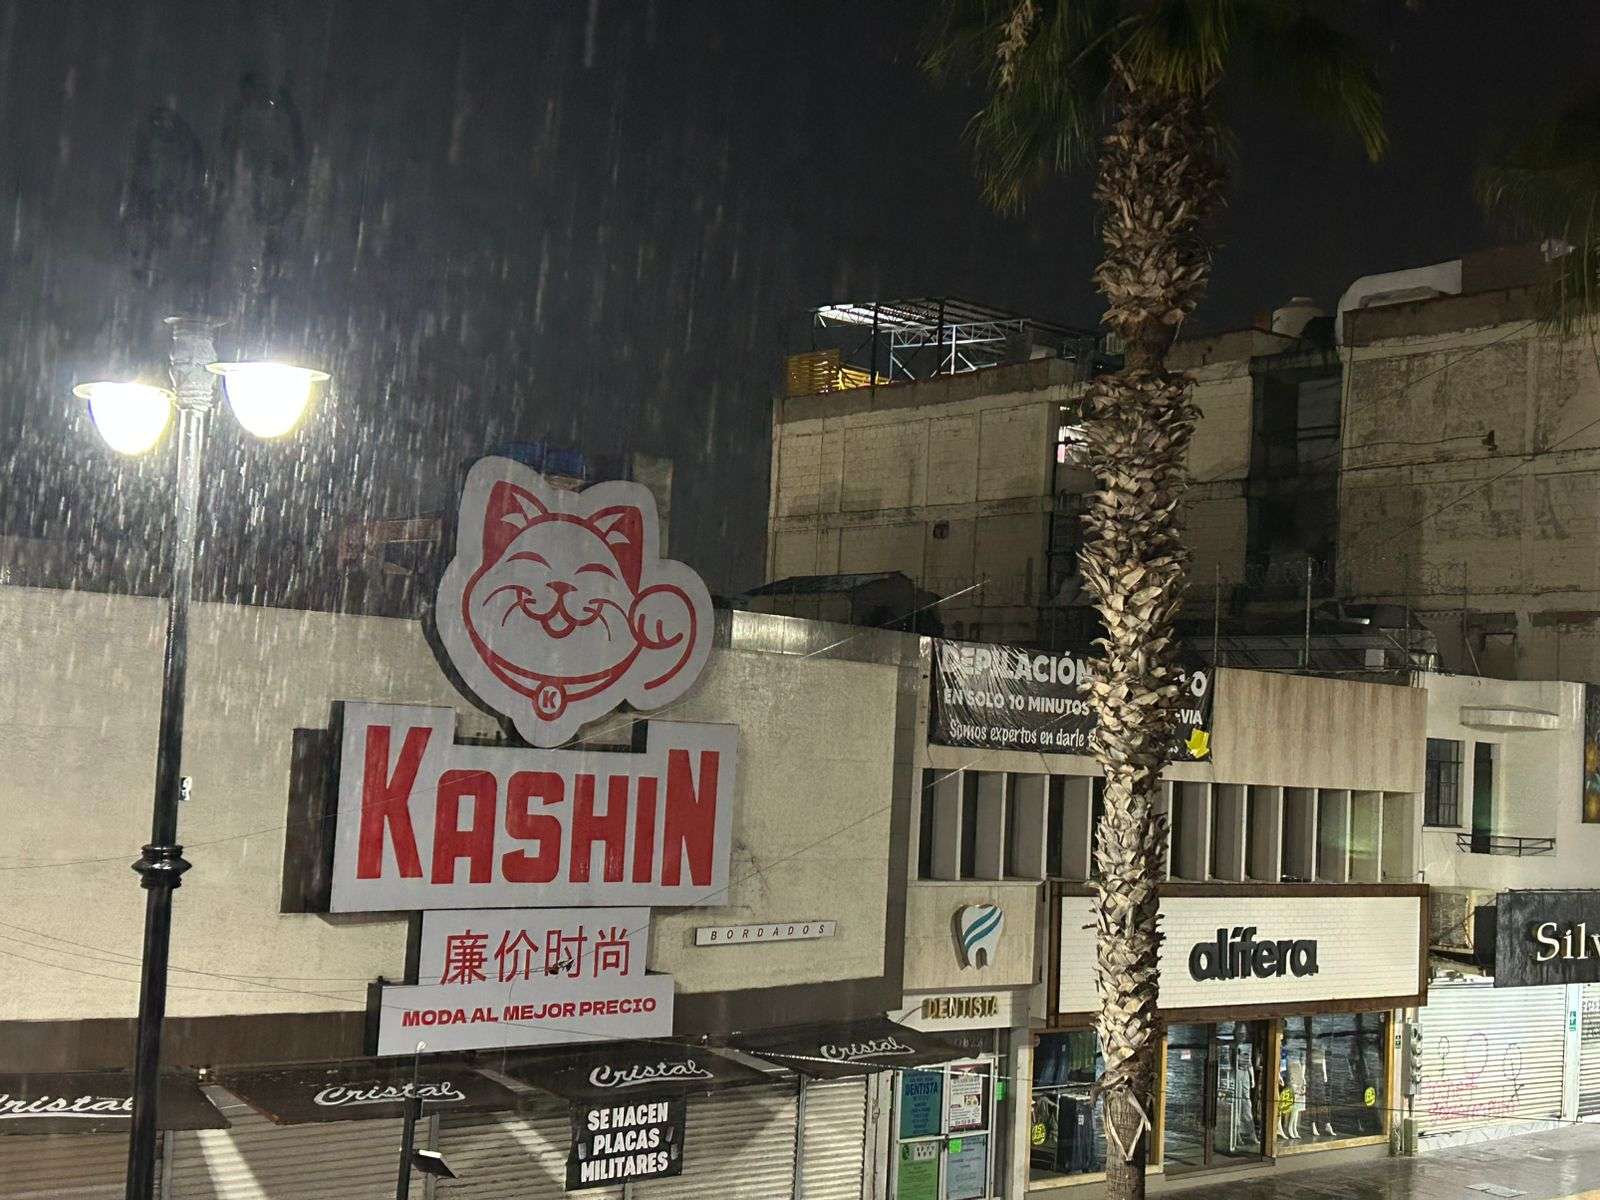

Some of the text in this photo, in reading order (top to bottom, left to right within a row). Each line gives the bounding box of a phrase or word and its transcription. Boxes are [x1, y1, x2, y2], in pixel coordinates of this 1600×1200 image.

[542, 689, 558, 709] K
[966, 690, 1005, 708] SOLO
[1009, 695, 1025, 710] 10
[1028, 696, 1090, 716] MINUTOS
[950, 719, 987, 740] Somos
[990, 726, 1037, 745] expertos
[1040, 731, 1053, 744] en
[1056, 728, 1085, 748] darle
[356, 725, 720, 886] KASHIN
[710, 924, 825, 941] BORDADOS
[439, 926, 630, 985] 廉价时尚
[402, 997, 657, 1027] MODA AL MEJOR PRECIO
[922, 995, 999, 1019] DENTISTA
[821, 1036, 915, 1060] Cristal
[589, 1060, 714, 1088] Cristal
[314, 1082, 466, 1106] Cristal
[587, 1102, 669, 1131] SE HACEN
[593, 1127, 660, 1155] PLACAS
[581, 1151, 668, 1182] MILITARES
